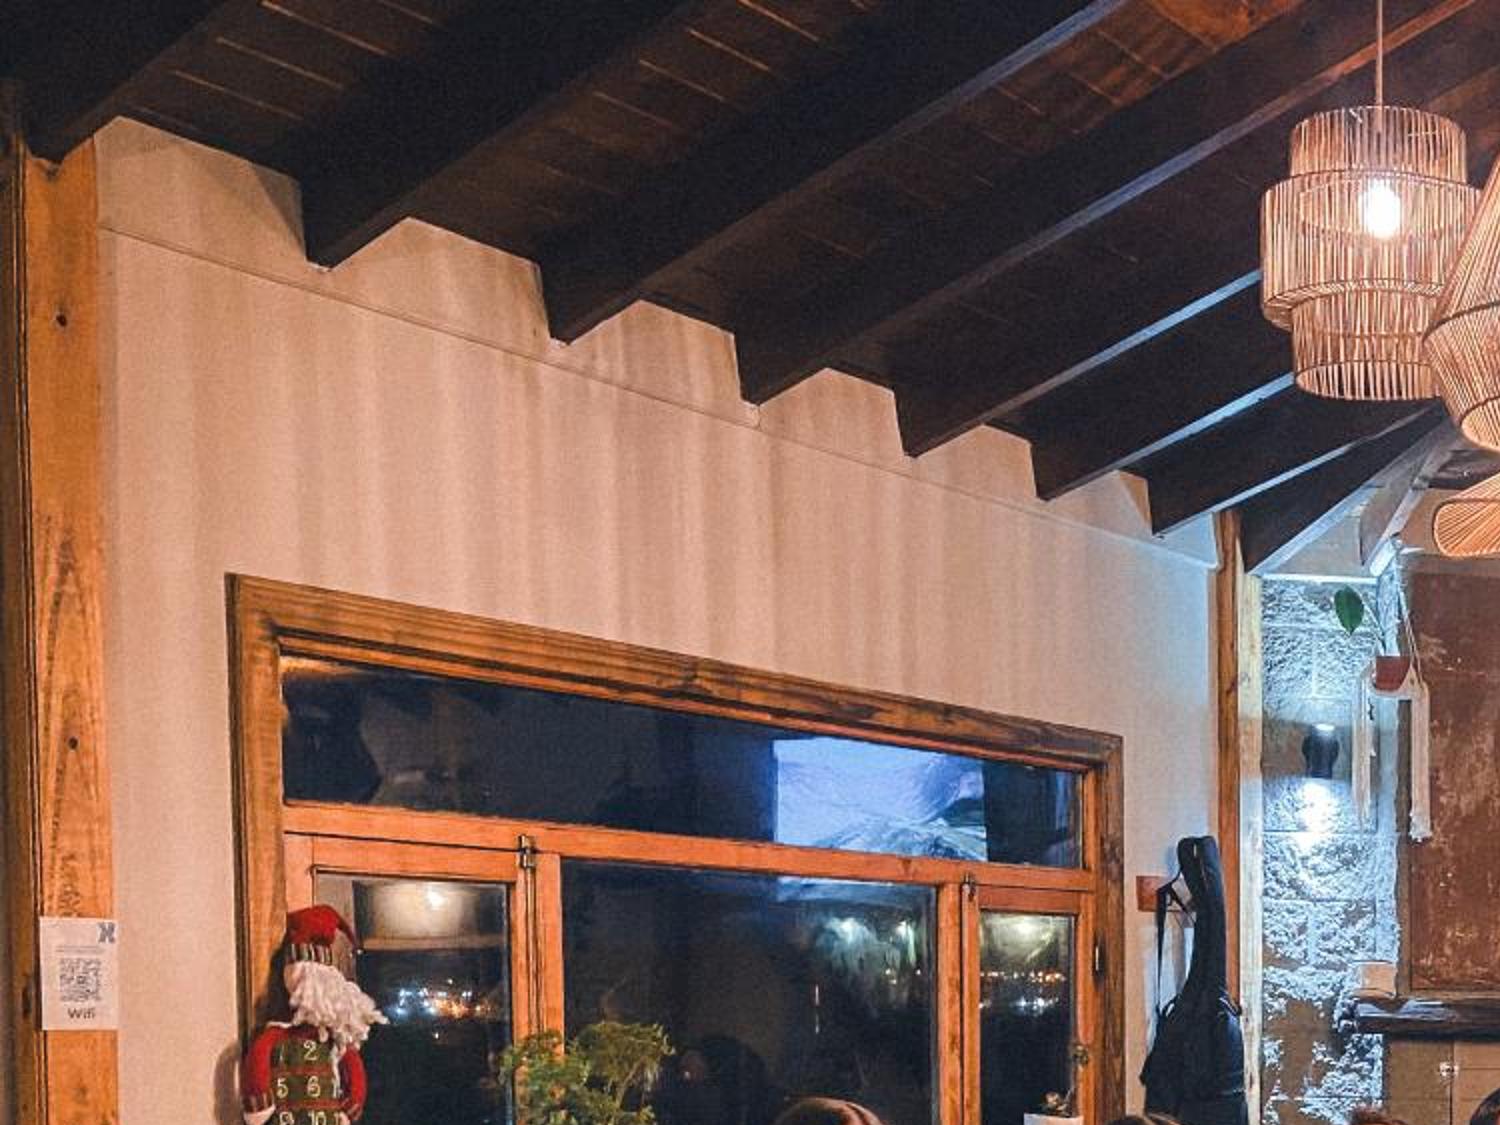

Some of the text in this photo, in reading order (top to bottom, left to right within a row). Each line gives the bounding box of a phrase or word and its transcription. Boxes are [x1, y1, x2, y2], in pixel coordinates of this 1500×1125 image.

[67, 1007, 96, 1019] Wifi
[303, 1040, 319, 1061] 2
[276, 1077, 289, 1099] 5
[307, 1075, 321, 1098] 6
